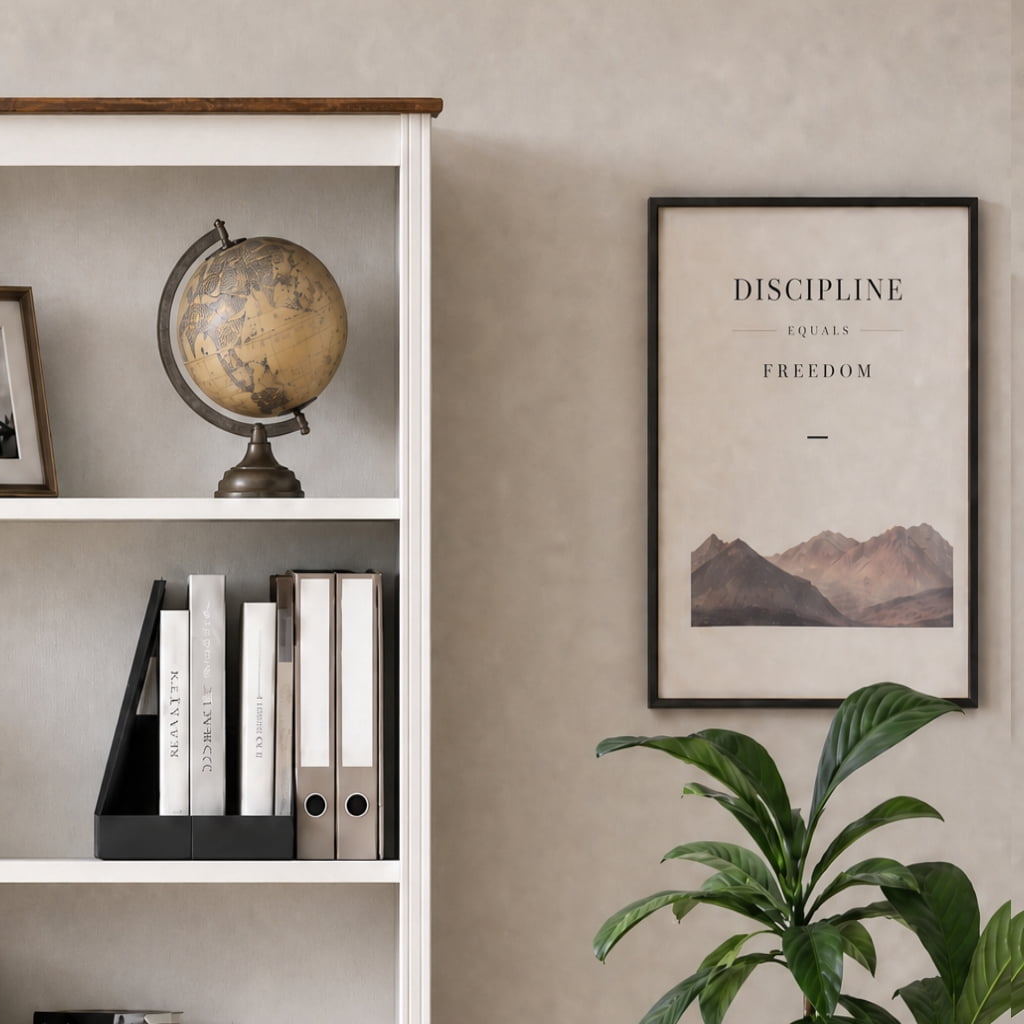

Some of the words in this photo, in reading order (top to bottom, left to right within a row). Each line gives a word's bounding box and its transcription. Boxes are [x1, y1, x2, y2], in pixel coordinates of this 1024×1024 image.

[733, 277, 904, 302] DISCIPLINE
[787, 325, 850, 338] EQUALS
[763, 363, 872, 379] FREEDOM
